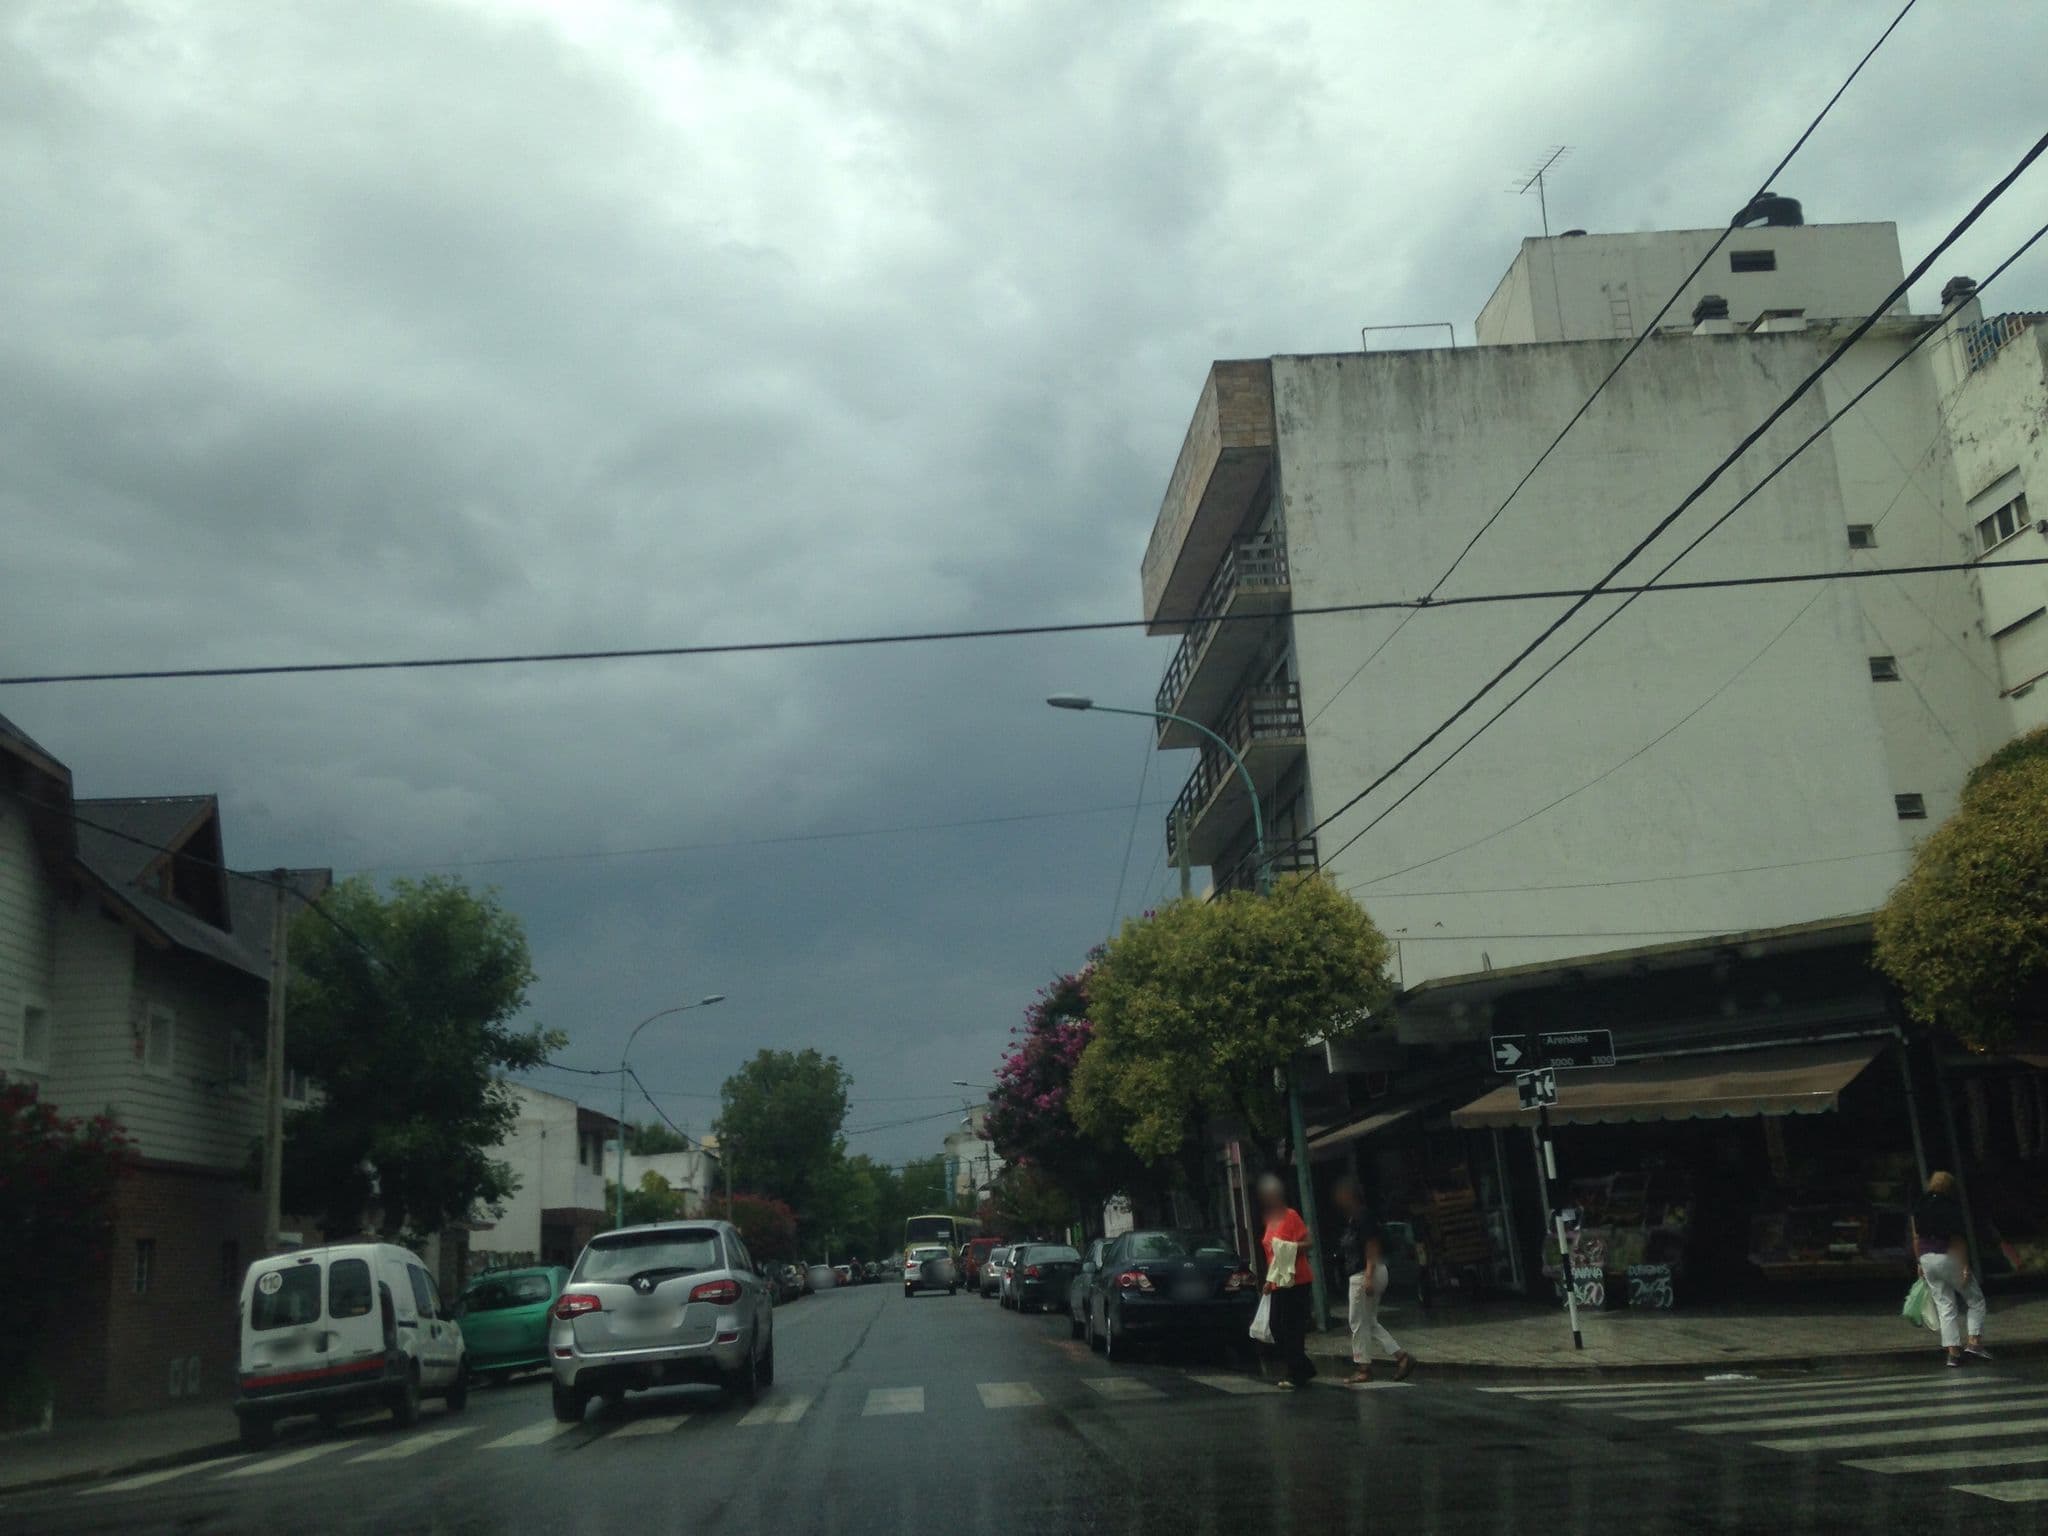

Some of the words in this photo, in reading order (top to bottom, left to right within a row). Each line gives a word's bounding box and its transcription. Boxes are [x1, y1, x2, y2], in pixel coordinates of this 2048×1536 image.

[1546, 1035, 1589, 1045] Arenales
[1550, 1057, 1575, 1066] 3000
[1592, 1056, 1613, 1065] 3100
